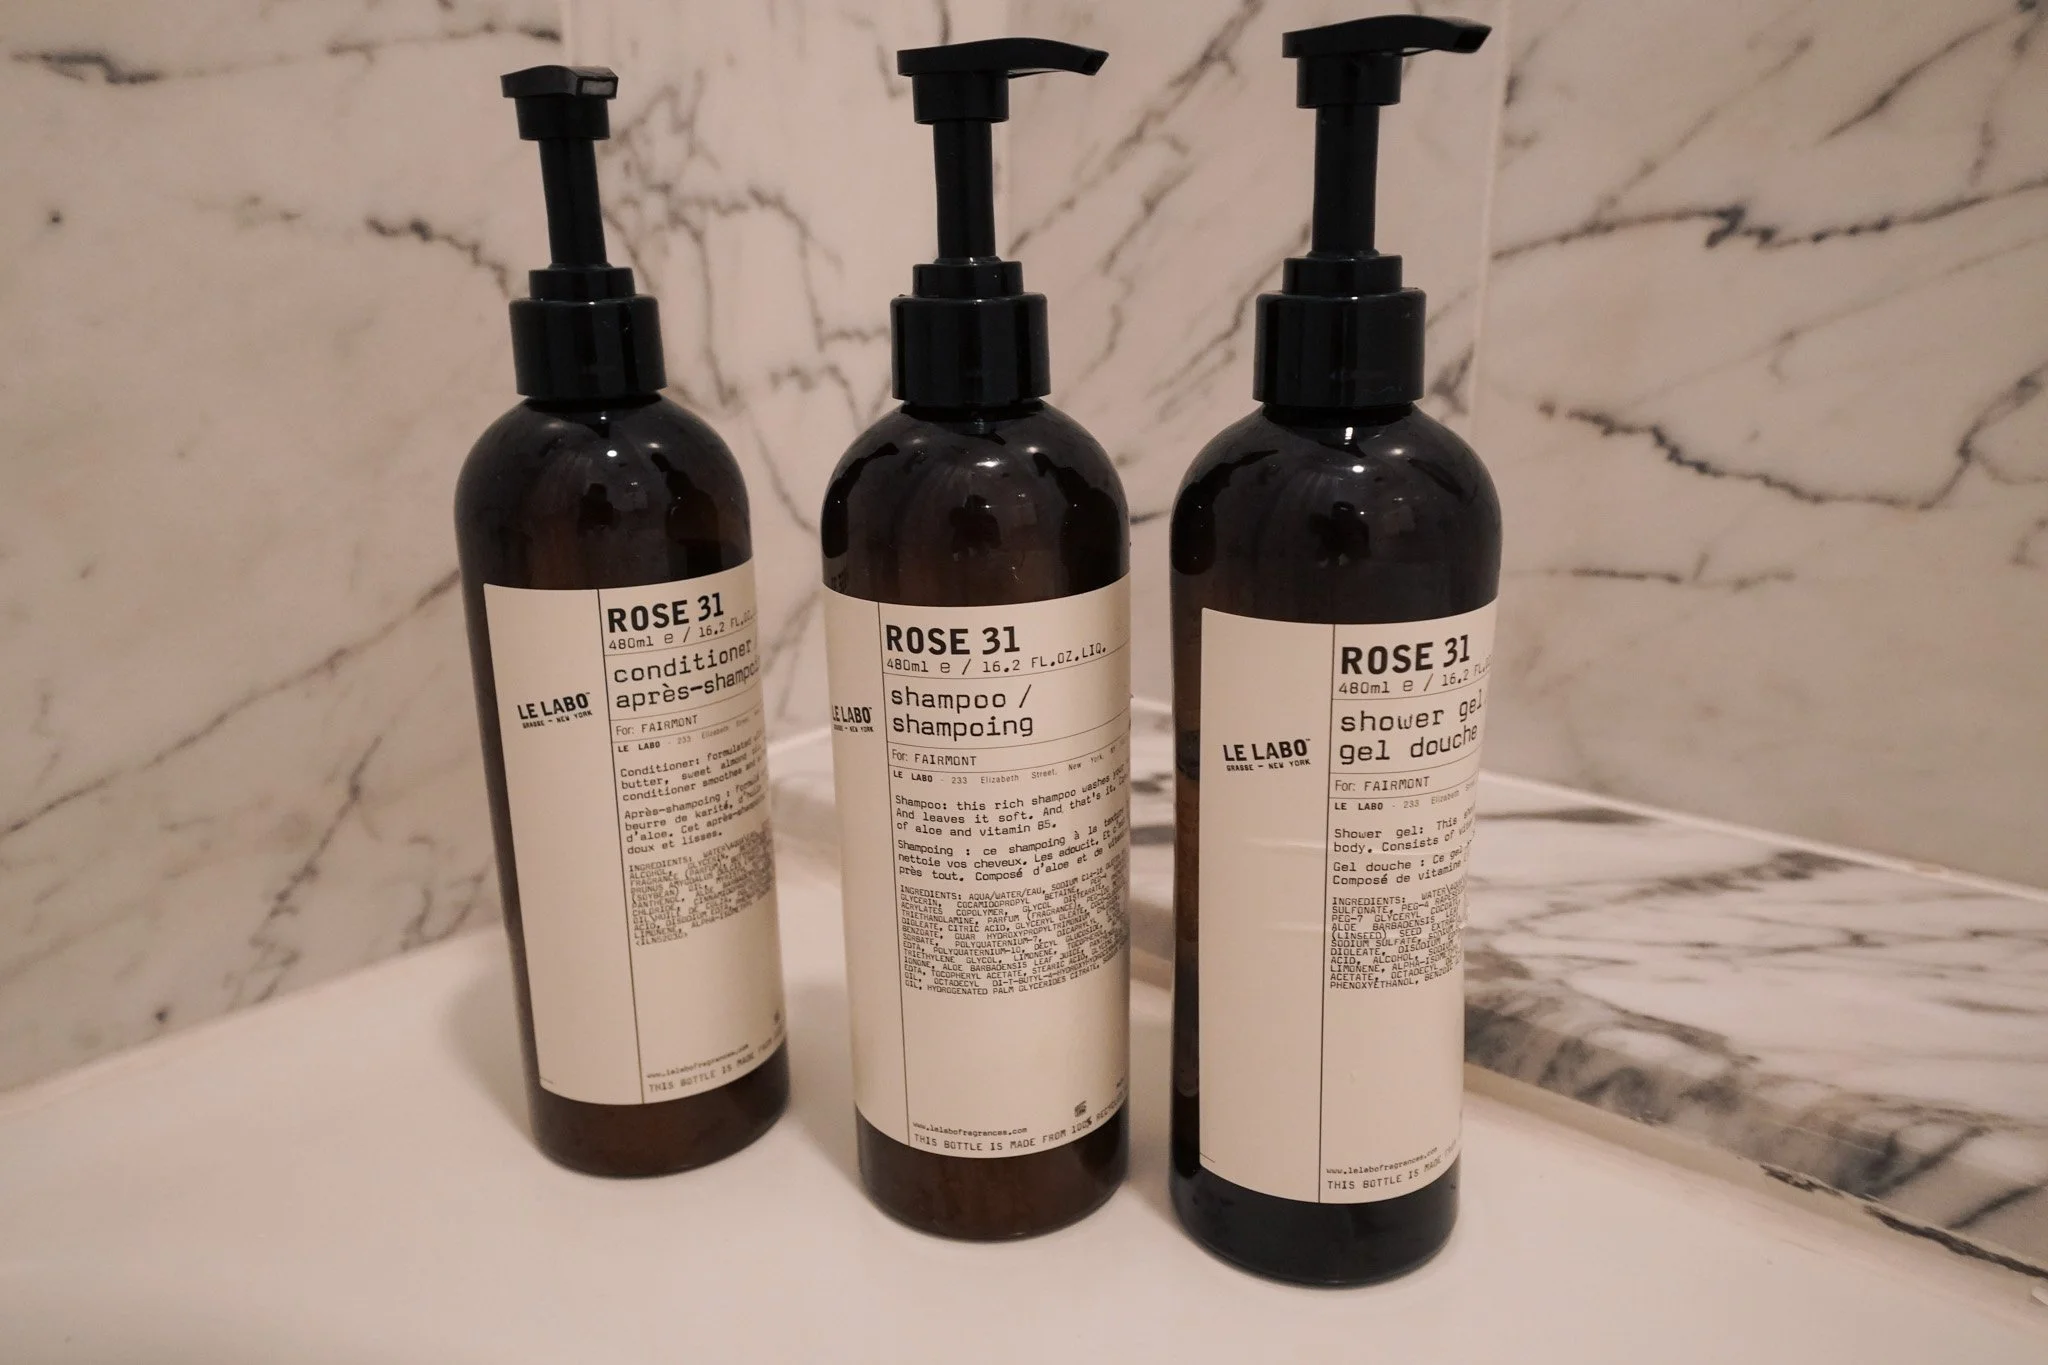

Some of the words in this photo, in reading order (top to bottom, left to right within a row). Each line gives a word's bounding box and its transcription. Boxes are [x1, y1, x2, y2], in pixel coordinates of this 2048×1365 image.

[608, 600, 690, 633] ROSE
[697, 592, 724, 622] 31
[608, 636, 654, 650] 480ml
[682, 626, 691, 642] /
[699, 622, 725, 638] 16.2
[886, 624, 970, 655] ROSE
[982, 626, 1020, 655] 31
[614, 638, 752, 683] conditioner
[886, 658, 928, 673] 480ml
[962, 658, 972, 675] /
[982, 659, 1020, 673] 16.2
[1032, 642, 1106, 668] FL.OZ.LIQ.
[1341, 641, 1434, 675] ROSE
[1443, 634, 1470, 668] 31
[1339, 681, 1390, 695] 480ml
[1423, 673, 1434, 691] /
[1442, 668, 1469, 687] 16.2
[517, 703, 538, 719] LE
[541, 693, 588, 716] LABO
[892, 686, 1006, 714] shampoo
[1019, 684, 1032, 708] /
[1341, 708, 1445, 732] shower
[1460, 688, 1482, 722] gel
[574, 710, 592, 719] YORK
[616, 724, 635, 736] For:
[641, 714, 698, 733] FAIRMONT
[832, 705, 840, 721] LE
[841, 706, 871, 723] LABO
[893, 714, 1033, 742] shampoing
[618, 744, 629, 752] LE
[638, 740, 660, 750] LABO
[1223, 744, 1245, 762] LE
[1252, 739, 1309, 760] LABO
[1339, 740, 1390, 765] gel
[1411, 725, 1477, 758] douche
[620, 758, 700, 778] Conditioner:
[892, 749, 908, 761] For:
[914, 752, 977, 766] FAIRMONT
[1226, 763, 1254, 772] GRASSE
[1268, 761, 1284, 770] NEW
[1289, 758, 1311, 768] YORK
[622, 777, 668, 789] butter,
[682, 766, 711, 780] sweet
[894, 770, 903, 779] LE
[911, 773, 933, 782] LABO
[980, 774, 1019, 784] Elizabeth
[1068, 762, 1081, 771] New
[1335, 779, 1355, 792] For:
[1364, 776, 1430, 792] FAIRMONT
[623, 783, 696, 801] conditioner
[896, 795, 947, 810] Shampoo:
[957, 801, 986, 810] this
[994, 798, 1024, 809] rich
[1032, 789, 1076, 806] shampoo
[1082, 775, 1110, 793] washes
[625, 793, 720, 819] Après-shampoing
[897, 808, 914, 819] And
[923, 812, 965, 823] leaves
[974, 814, 989, 823] it
[998, 811, 1034, 823] soft.
[1043, 805, 1062, 816] And
[1070, 792, 1101, 809] that's
[1105, 785, 1116, 796] it.
[1358, 802, 1383, 810] LABO
[1403, 800, 1420, 809] 233
[625, 820, 666, 830] beurre
[675, 815, 687, 823] de
[626, 831, 673, 842] d'aloe.
[681, 822, 700, 834] Cet
[897, 822, 908, 830] of
[916, 825, 942, 835] aloe
[950, 828, 972, 837] and
[980, 824, 1031, 836] vitamin
[1038, 821, 1056, 830] B5.
[1334, 828, 1382, 839] Shower
[1396, 826, 1424, 839] gel:
[1436, 816, 1457, 831] This
[628, 845, 655, 854] doux
[662, 841, 674, 849] et
[682, 829, 722, 845] lisses.
[898, 840, 953, 856] Shampoing
[1009, 836, 1065, 853] shampoing
[1074, 831, 1080, 840] à
[1088, 826, 1098, 835] la
[1334, 842, 1372, 854] body.
[1382, 837, 1439, 852] Consists
[1444, 829, 1454, 842] of
[629, 856, 692, 872] INGREDIENTS:
[899, 853, 940, 866] nettoie
[947, 860, 967, 868] vos
[974, 857, 1027, 868] cheveux.
[1034, 852, 1053, 862] Les
[1059, 838, 1099, 857] adoucit.
[1333, 862, 1356, 872] Gel
[1366, 860, 1411, 871] douche
[1432, 854, 1445, 864] Ce
[899, 866, 922, 876] près
[932, 870, 963, 882] tout.
[975, 867, 1023, 882] Composé
[1033, 861, 1069, 876] d'aloe
[1077, 854, 1087, 864] et
[1094, 847, 1103, 857] de
[1333, 875, 1388, 887] Composé
[1396, 874, 1410, 884] de
[1418, 859, 1461, 881] vitamine
[900, 885, 961, 900] INGREDIENTS:
[1051, 877, 1078, 891] SODIUM
[900, 894, 941, 907] GLYCERIN,
[956, 898, 1030, 908] COCAMIDOPROPYL
[1332, 897, 1406, 906] INGREDIENTS:
[948, 924, 980, 932] CITRIC
[1016, 918, 1054, 929] GLYCERYL
[988, 914, 1020, 923] PARFUM
[1332, 923, 1356, 931] ALOE
[1374, 912, 1421, 922] GLYCERYL
[1400, 927, 1421, 938] SEED
[1331, 940, 1369, 948] SODIUM
[943, 963, 963, 971] ALOE
[992, 986, 1014, 994] PALM
[649, 1082, 674, 1093] THIS
[680, 1070, 716, 1087] BOTTLE
[722, 1064, 732, 1074] IS
[912, 1121, 1028, 1137] www.lelabofragrances.com
[913, 1133, 938, 1147] THIS
[943, 1139, 983, 1151] BOTTLE
[990, 1142, 1003, 1151] IS
[1010, 1138, 1036, 1149] MADE
[1043, 1130, 1066, 1143] FROM
[1326, 1146, 1438, 1175] www.lelabofragrances.com
[1327, 1179, 1356, 1190] THIS
[1363, 1174, 1402, 1189] BOTTLE
[1408, 1169, 1419, 1179] IS
